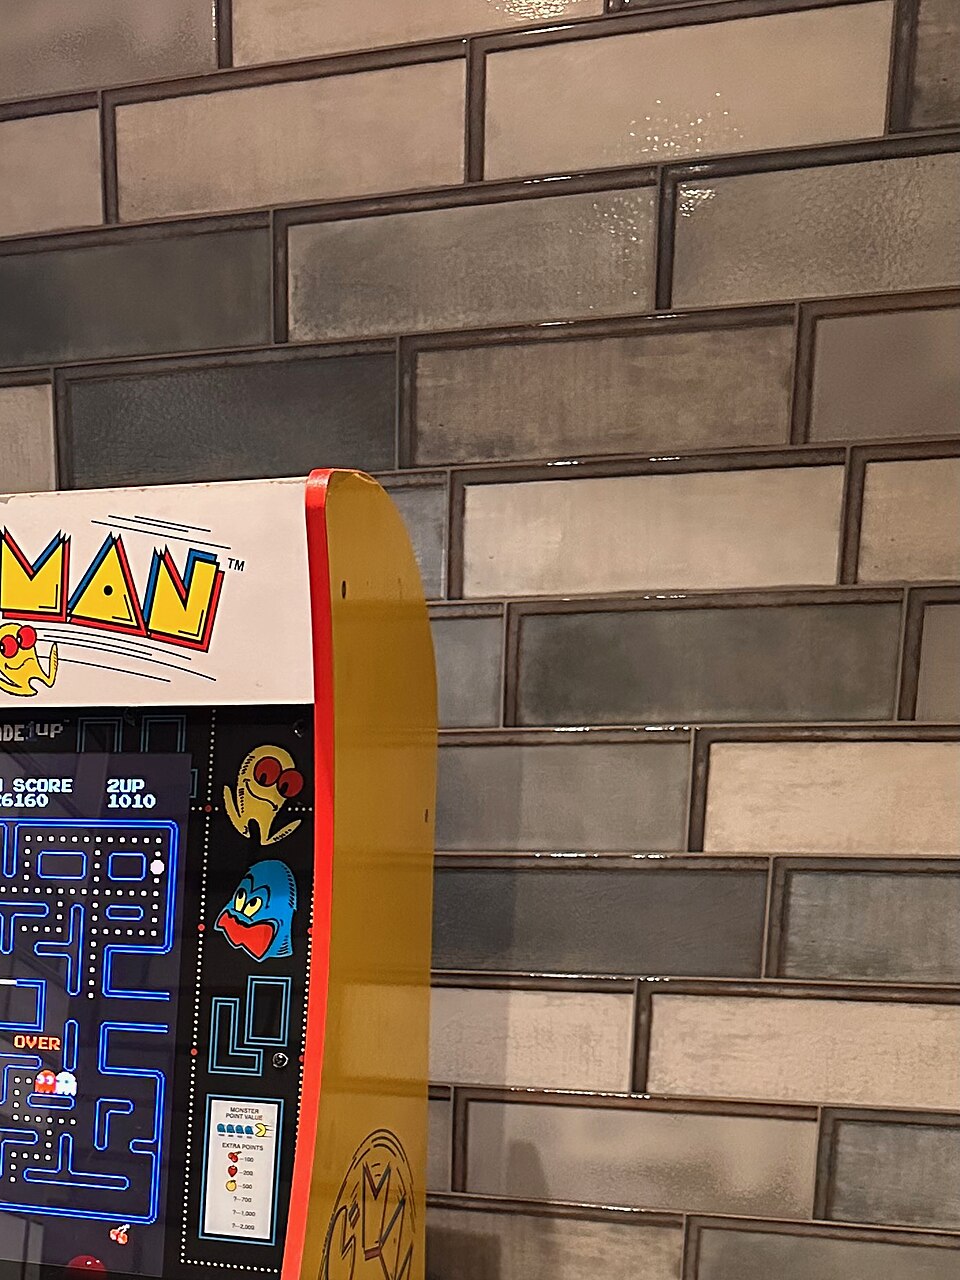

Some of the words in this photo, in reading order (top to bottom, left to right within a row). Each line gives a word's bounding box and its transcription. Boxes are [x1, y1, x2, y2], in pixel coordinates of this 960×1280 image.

[12, 778, 73, 793] SCORE
[106, 778, 145, 793] 2UP
[107, 793, 156, 809] 1010
[13, 1035, 61, 1051] OVER
[225, 1112, 244, 1120] POINT
[230, 1106, 260, 1114] MONSTER
[242, 1143, 264, 1151] POINTS
